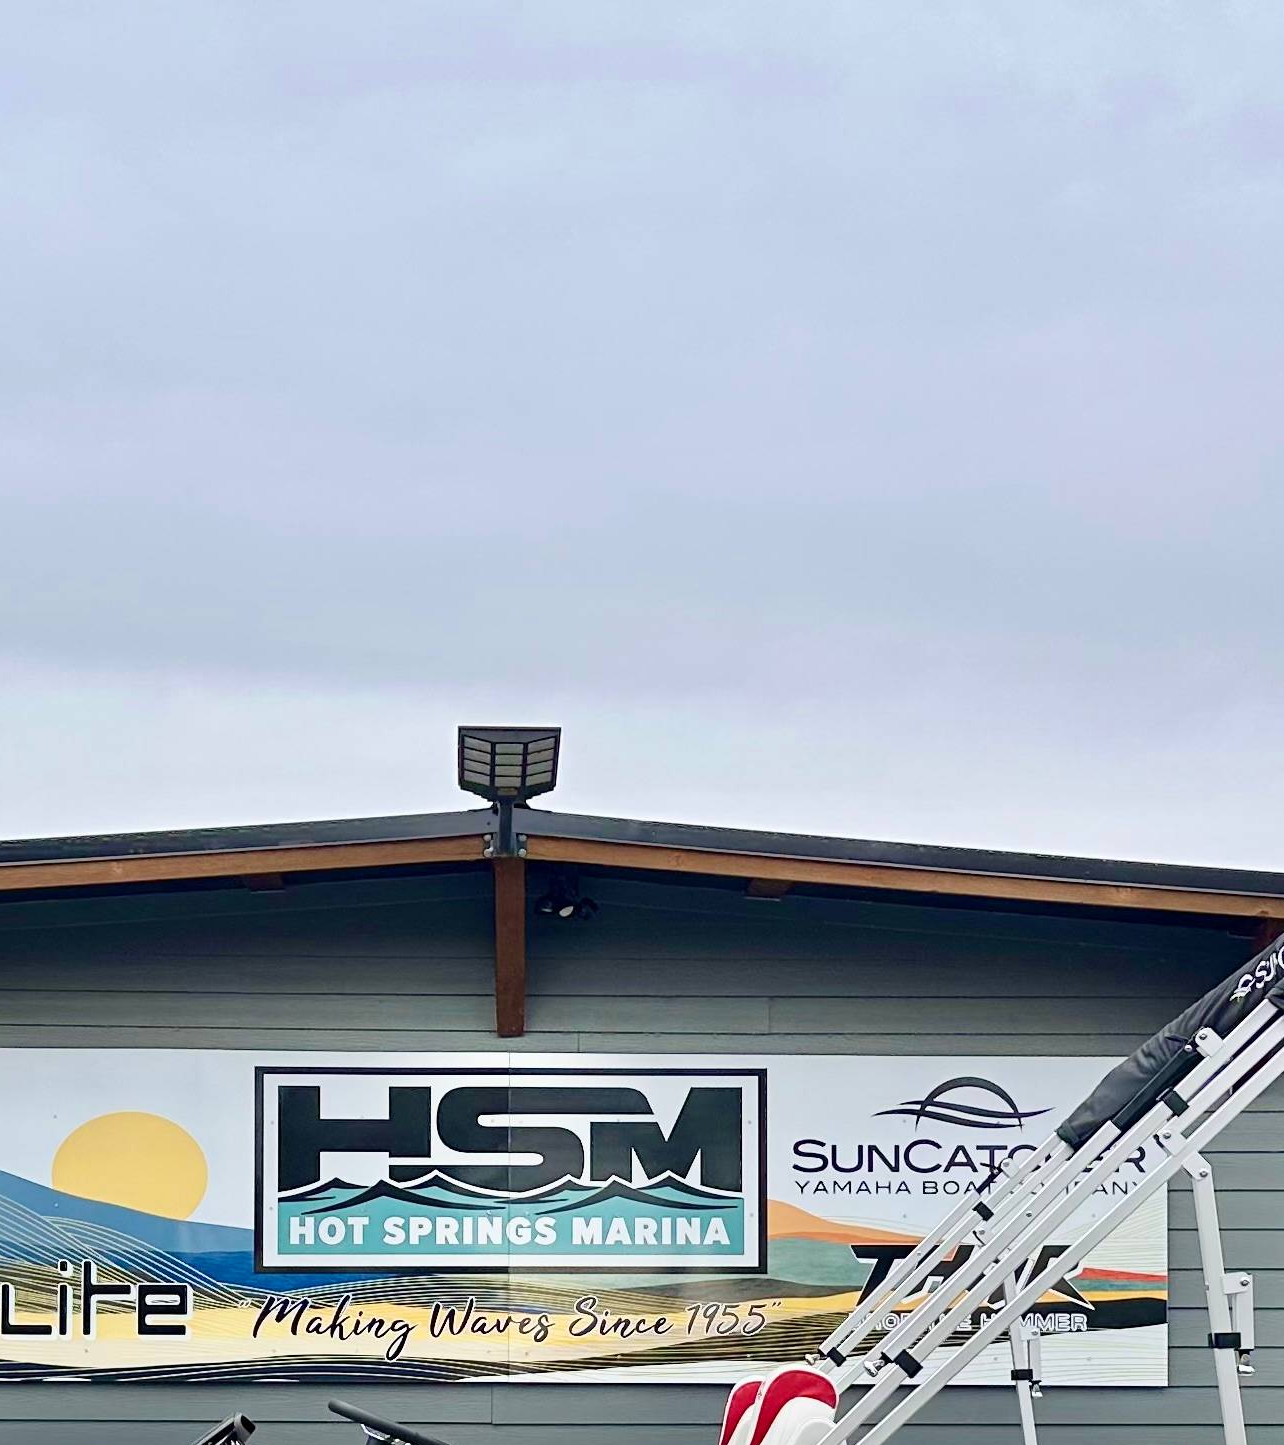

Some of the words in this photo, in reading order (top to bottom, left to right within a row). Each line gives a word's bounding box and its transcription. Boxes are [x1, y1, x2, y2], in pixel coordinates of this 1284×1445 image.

[278, 1086, 743, 1193] HSM
[795, 1181, 911, 1195] YAMAHA
[289, 1215, 369, 1245] HOT
[383, 1215, 556, 1246] SPRINGS
[571, 1216, 731, 1246] MARINA
[429, 1297, 555, 1343] Waves
[569, 1296, 674, 1338] Since
[981, 1313, 1087, 1331] HMMER
